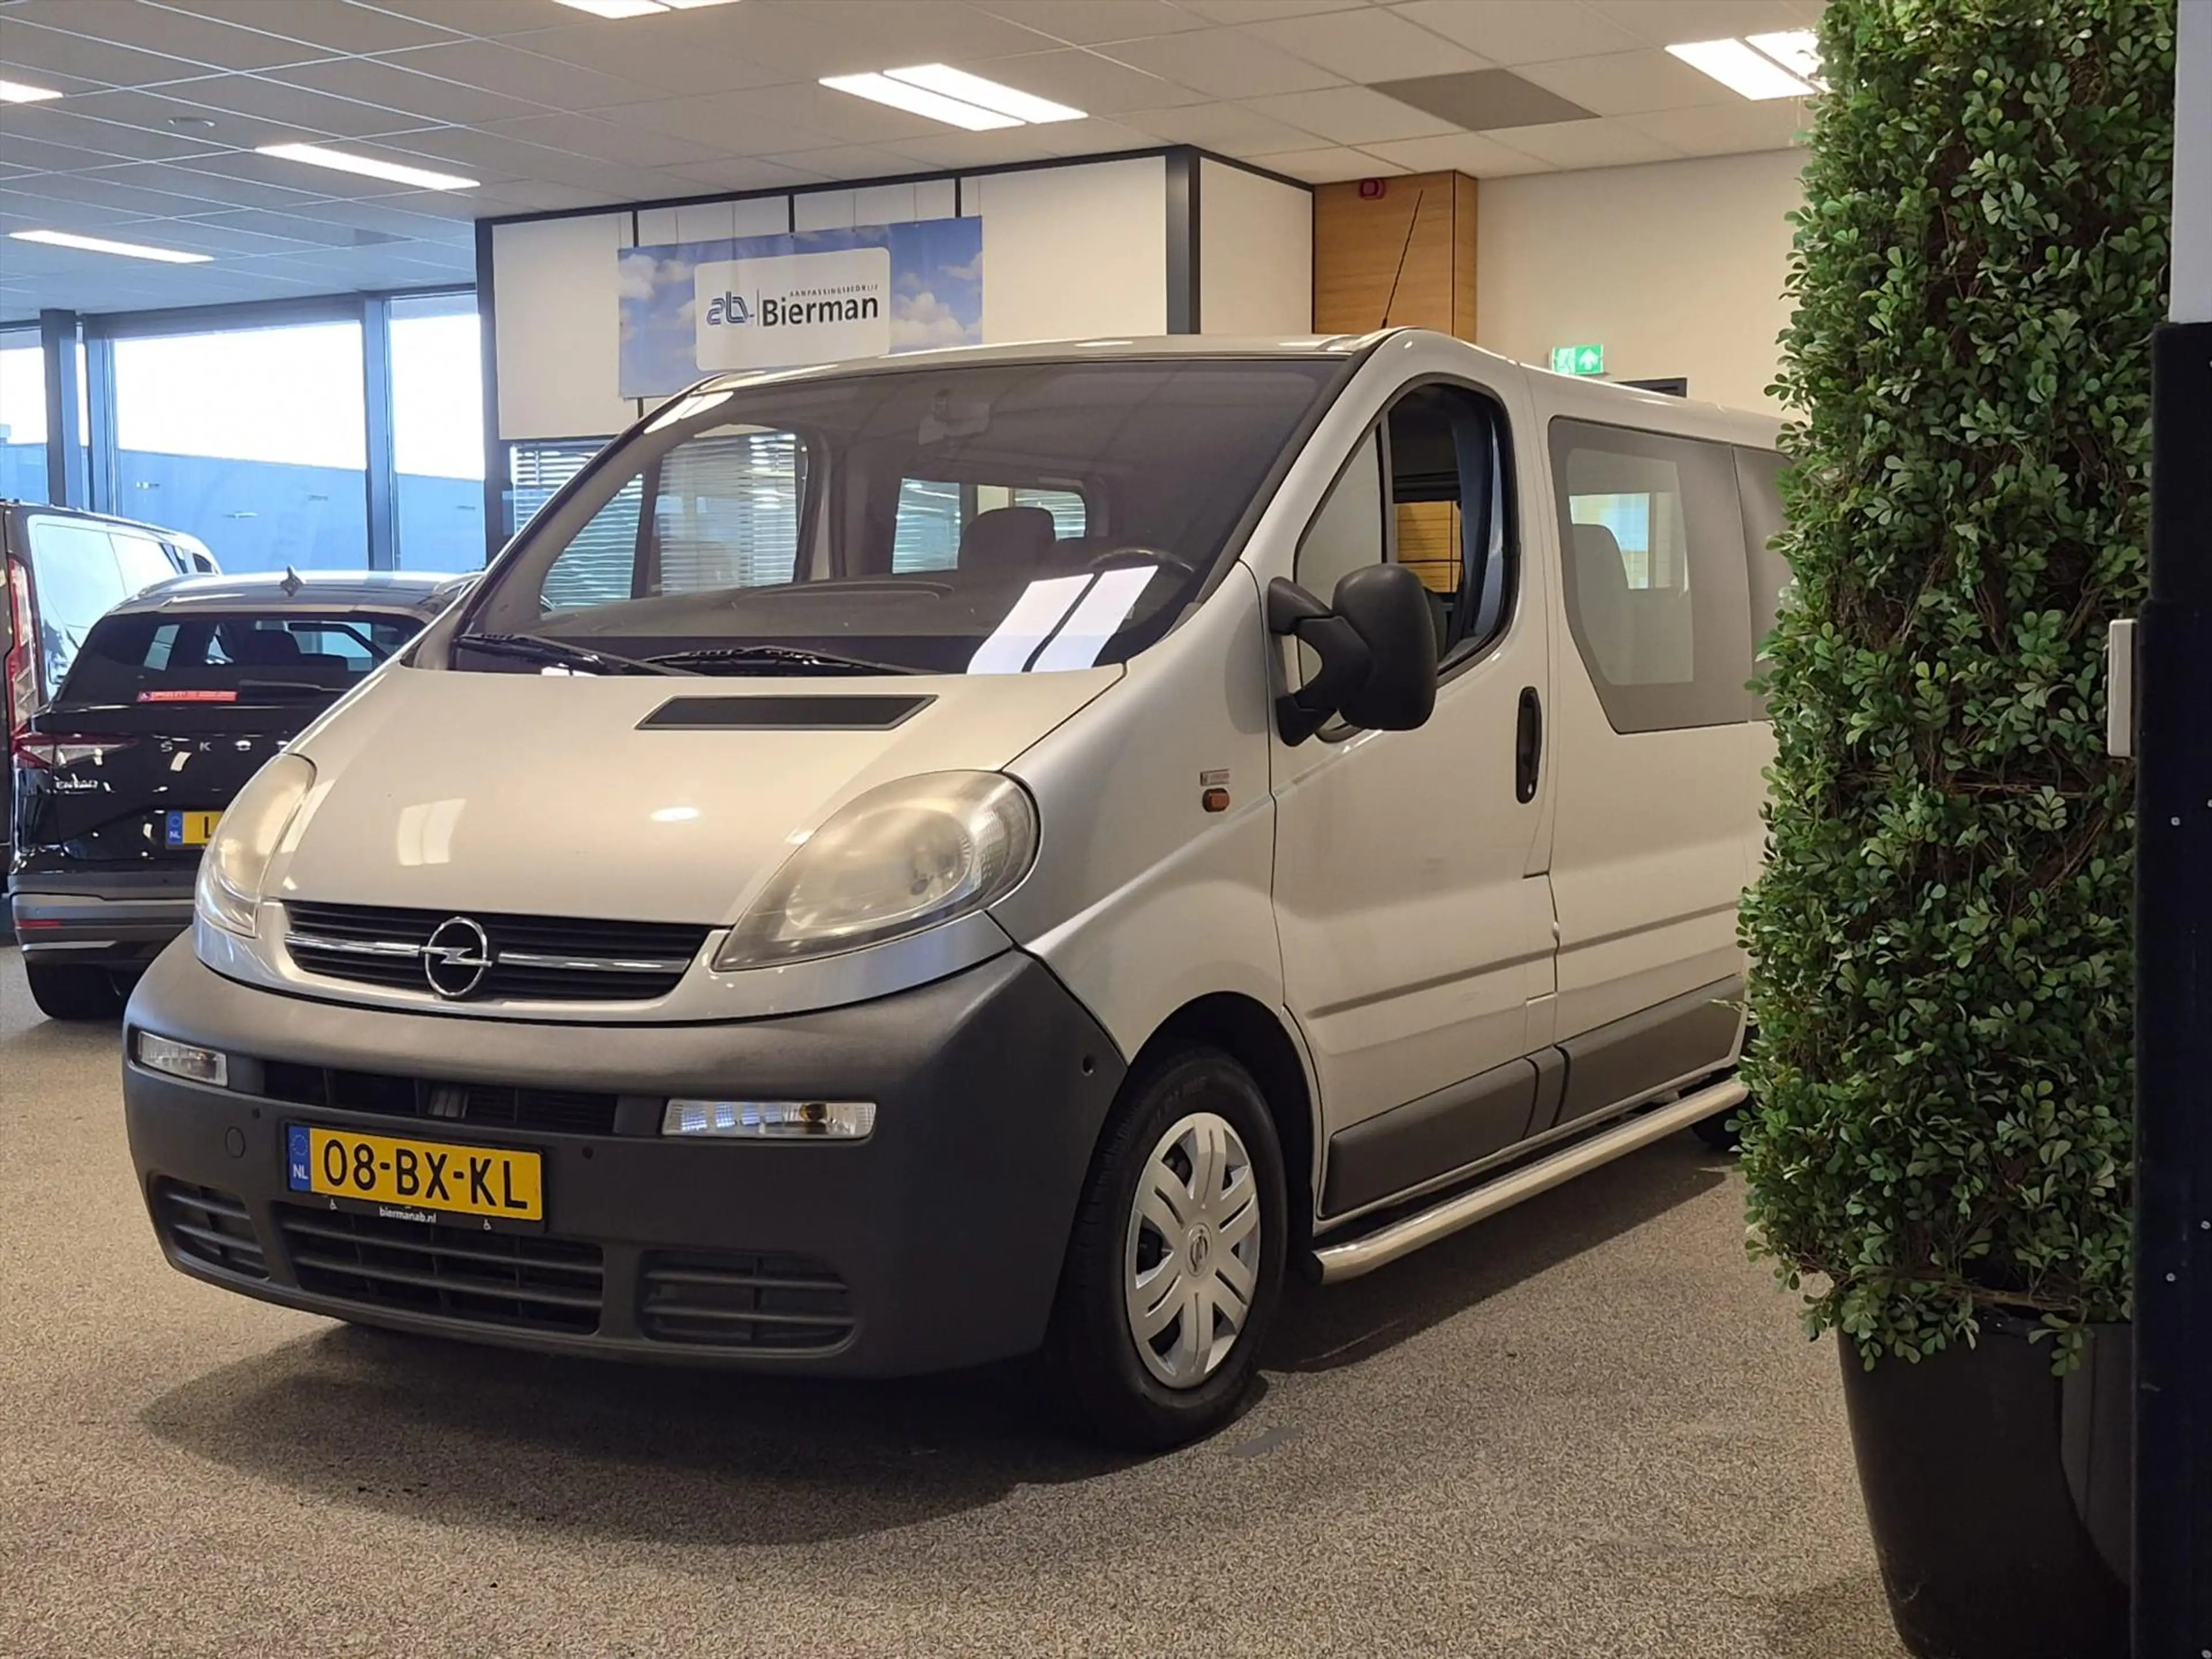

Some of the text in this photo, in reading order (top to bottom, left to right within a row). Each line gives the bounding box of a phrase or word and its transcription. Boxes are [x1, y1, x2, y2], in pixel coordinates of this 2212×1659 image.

[762, 297, 878, 327] Bierman
[293, 1165, 309, 1180] NL
[323, 1138, 528, 1210] 08-BX-KL
[379, 1206, 437, 1223] biermanab.nl
